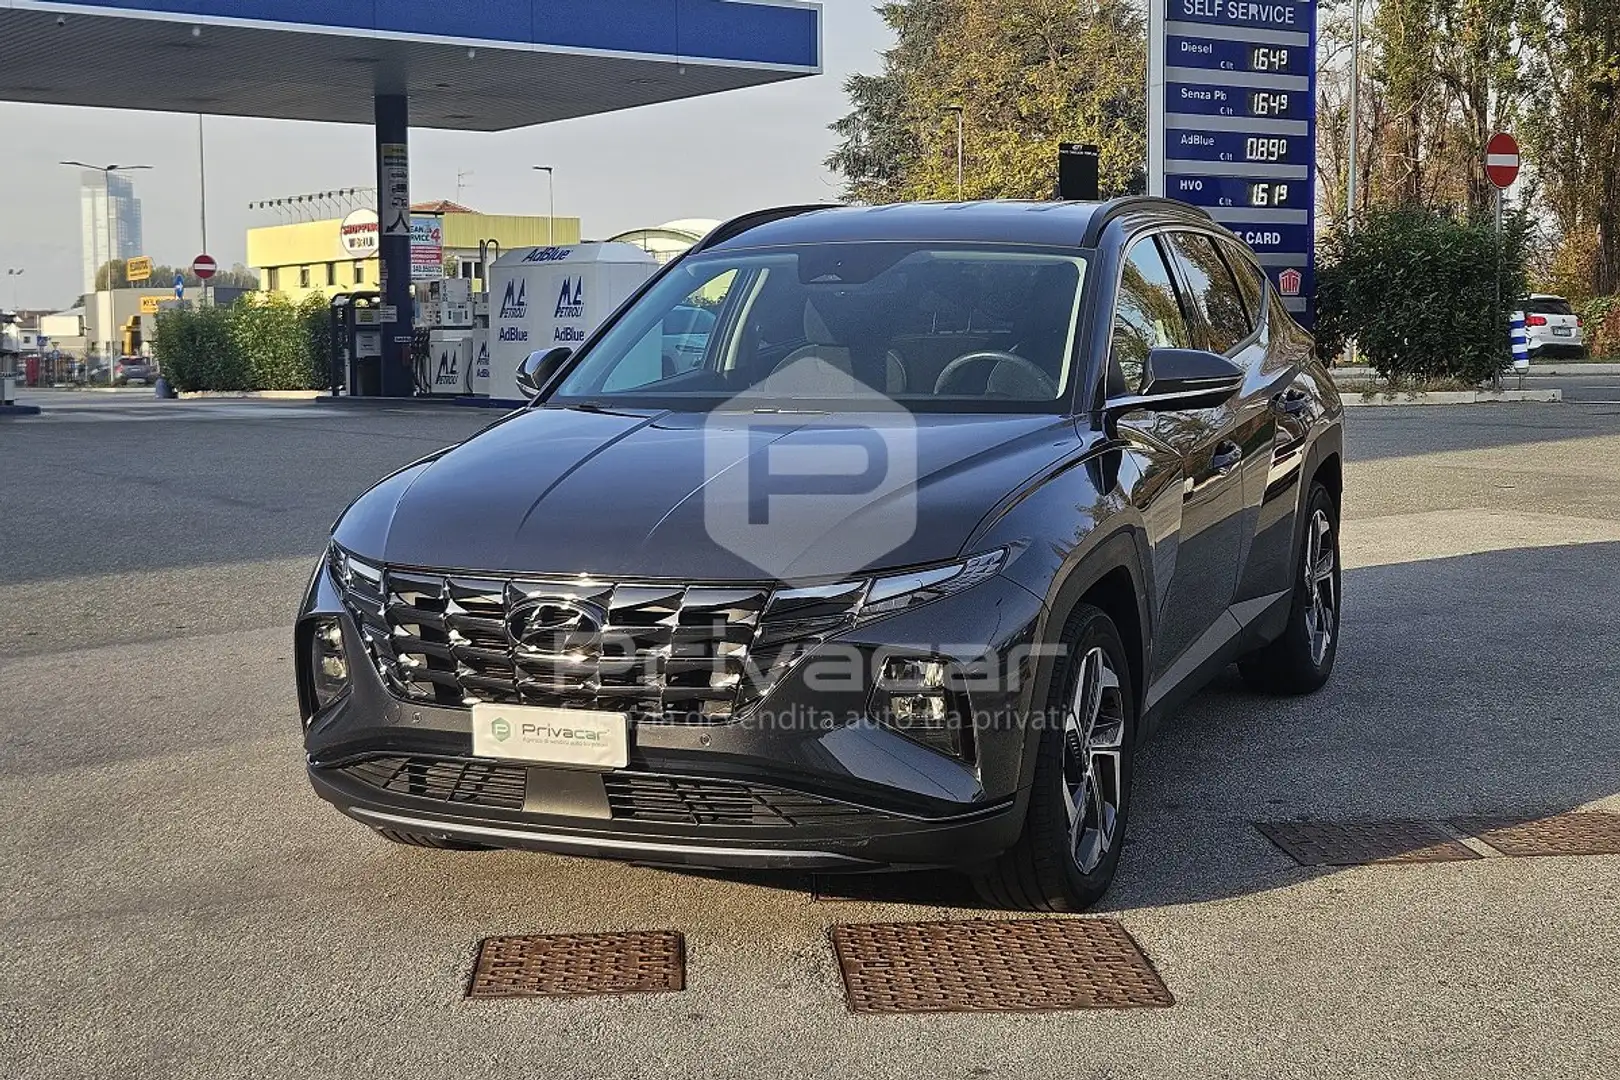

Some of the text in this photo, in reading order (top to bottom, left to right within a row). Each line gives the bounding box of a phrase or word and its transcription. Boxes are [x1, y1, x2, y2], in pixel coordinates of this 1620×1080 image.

[1183, 0, 1295, 24] SELF SERVICE
[1181, 41, 1213, 54] Diesel
[1181, 87, 1211, 100] Senza
[1214, 90, 1227, 101] Pb
[1181, 134, 1215, 146] AdBlue
[1180, 179, 1203, 191] HVO
[1246, 231, 1281, 245] CARD
[520, 246, 571, 262] AdBlue
[500, 307, 527, 318] PETROLI
[554, 306, 583, 318] PETROLI
[499, 327, 528, 341] AdBlue
[554, 327, 585, 341] AdBlue
[522, 723, 608, 741] Privacar
